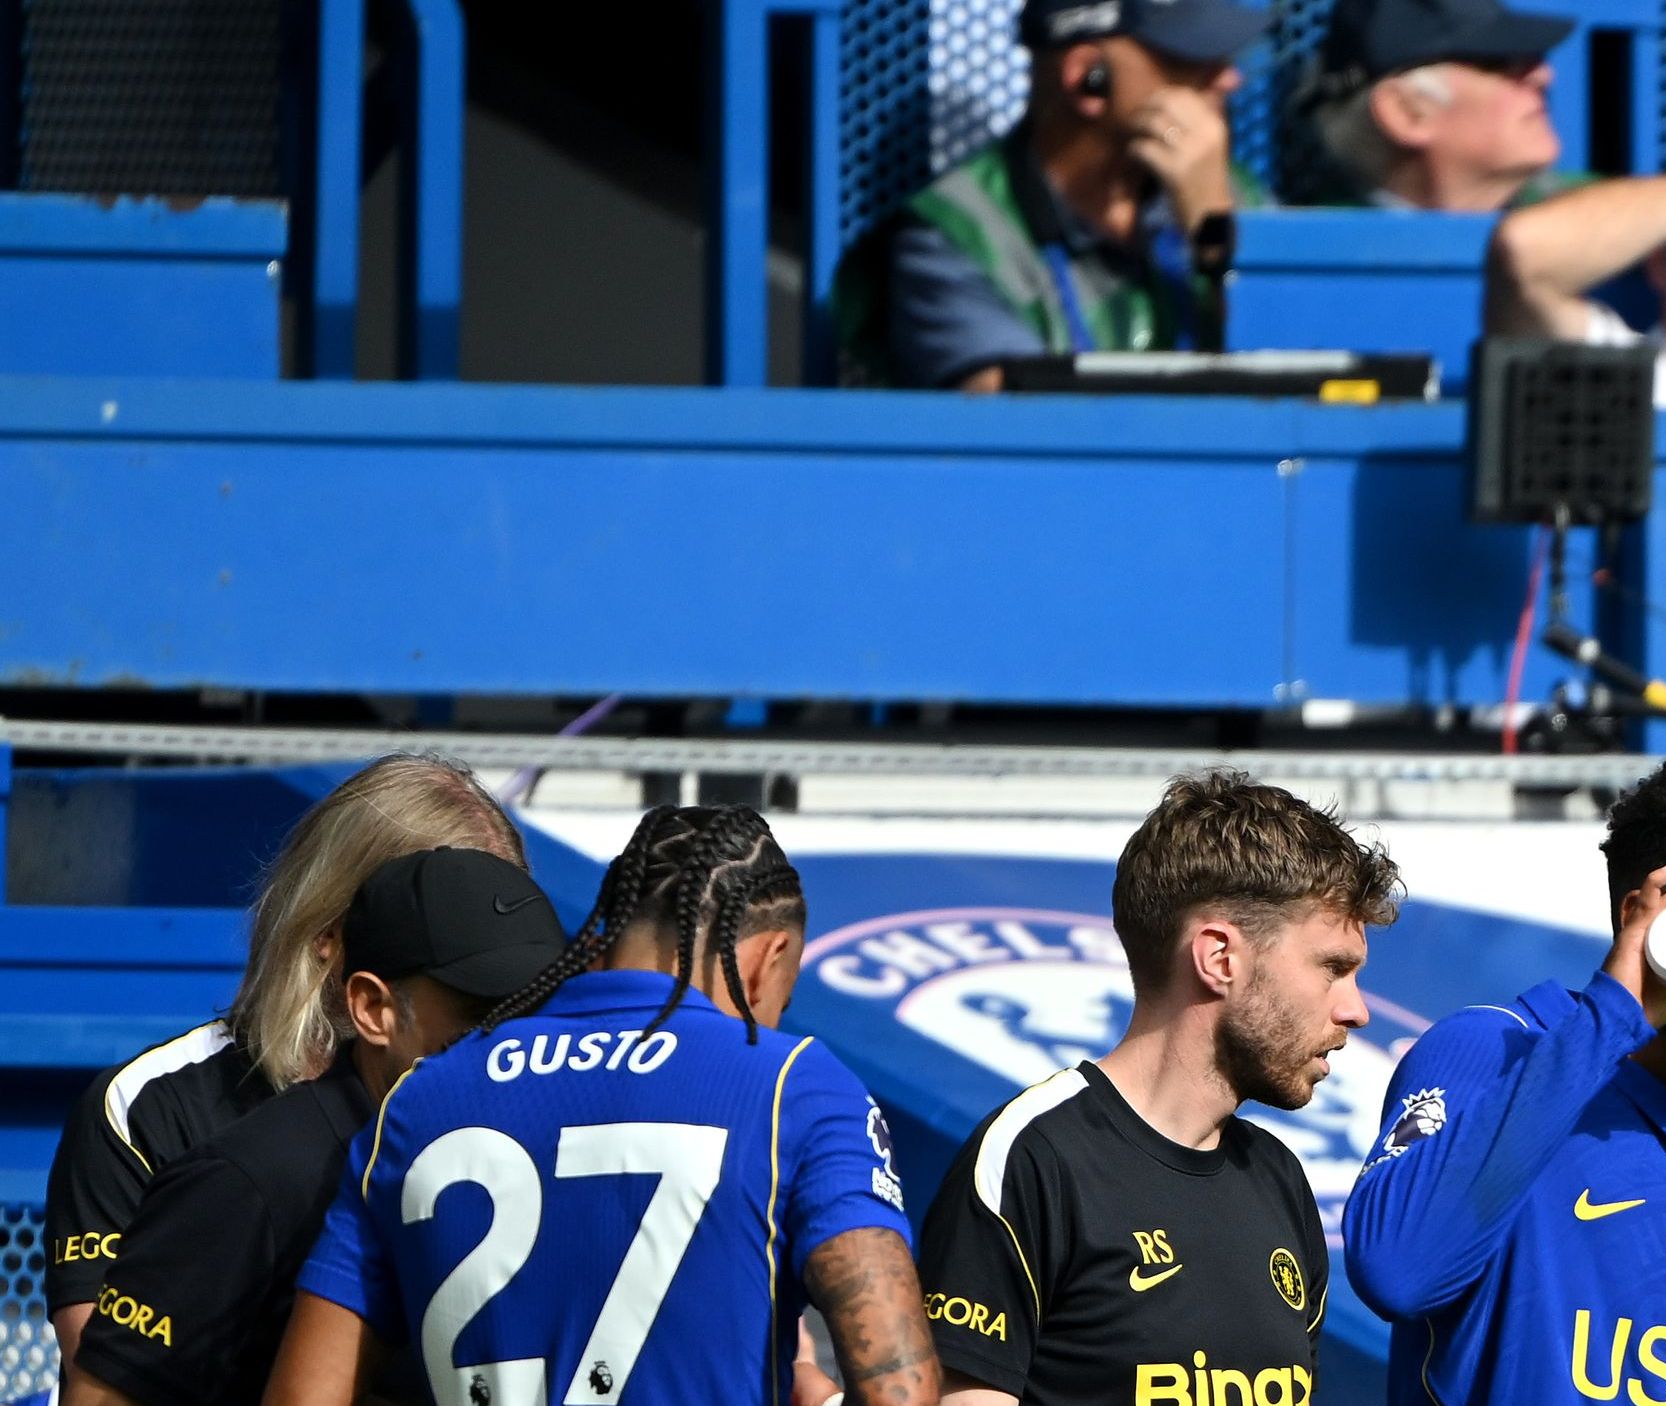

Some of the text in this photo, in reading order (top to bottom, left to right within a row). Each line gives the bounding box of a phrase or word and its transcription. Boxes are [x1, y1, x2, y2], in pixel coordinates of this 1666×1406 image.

[819, 921, 1127, 998] CHELS
[486, 1030, 678, 1082] GUSTO
[55, 1231, 122, 1265] LEGO
[1132, 1229, 1174, 1265] RS
[97, 1284, 172, 1347] GORA
[924, 1293, 1006, 1341] GORA
